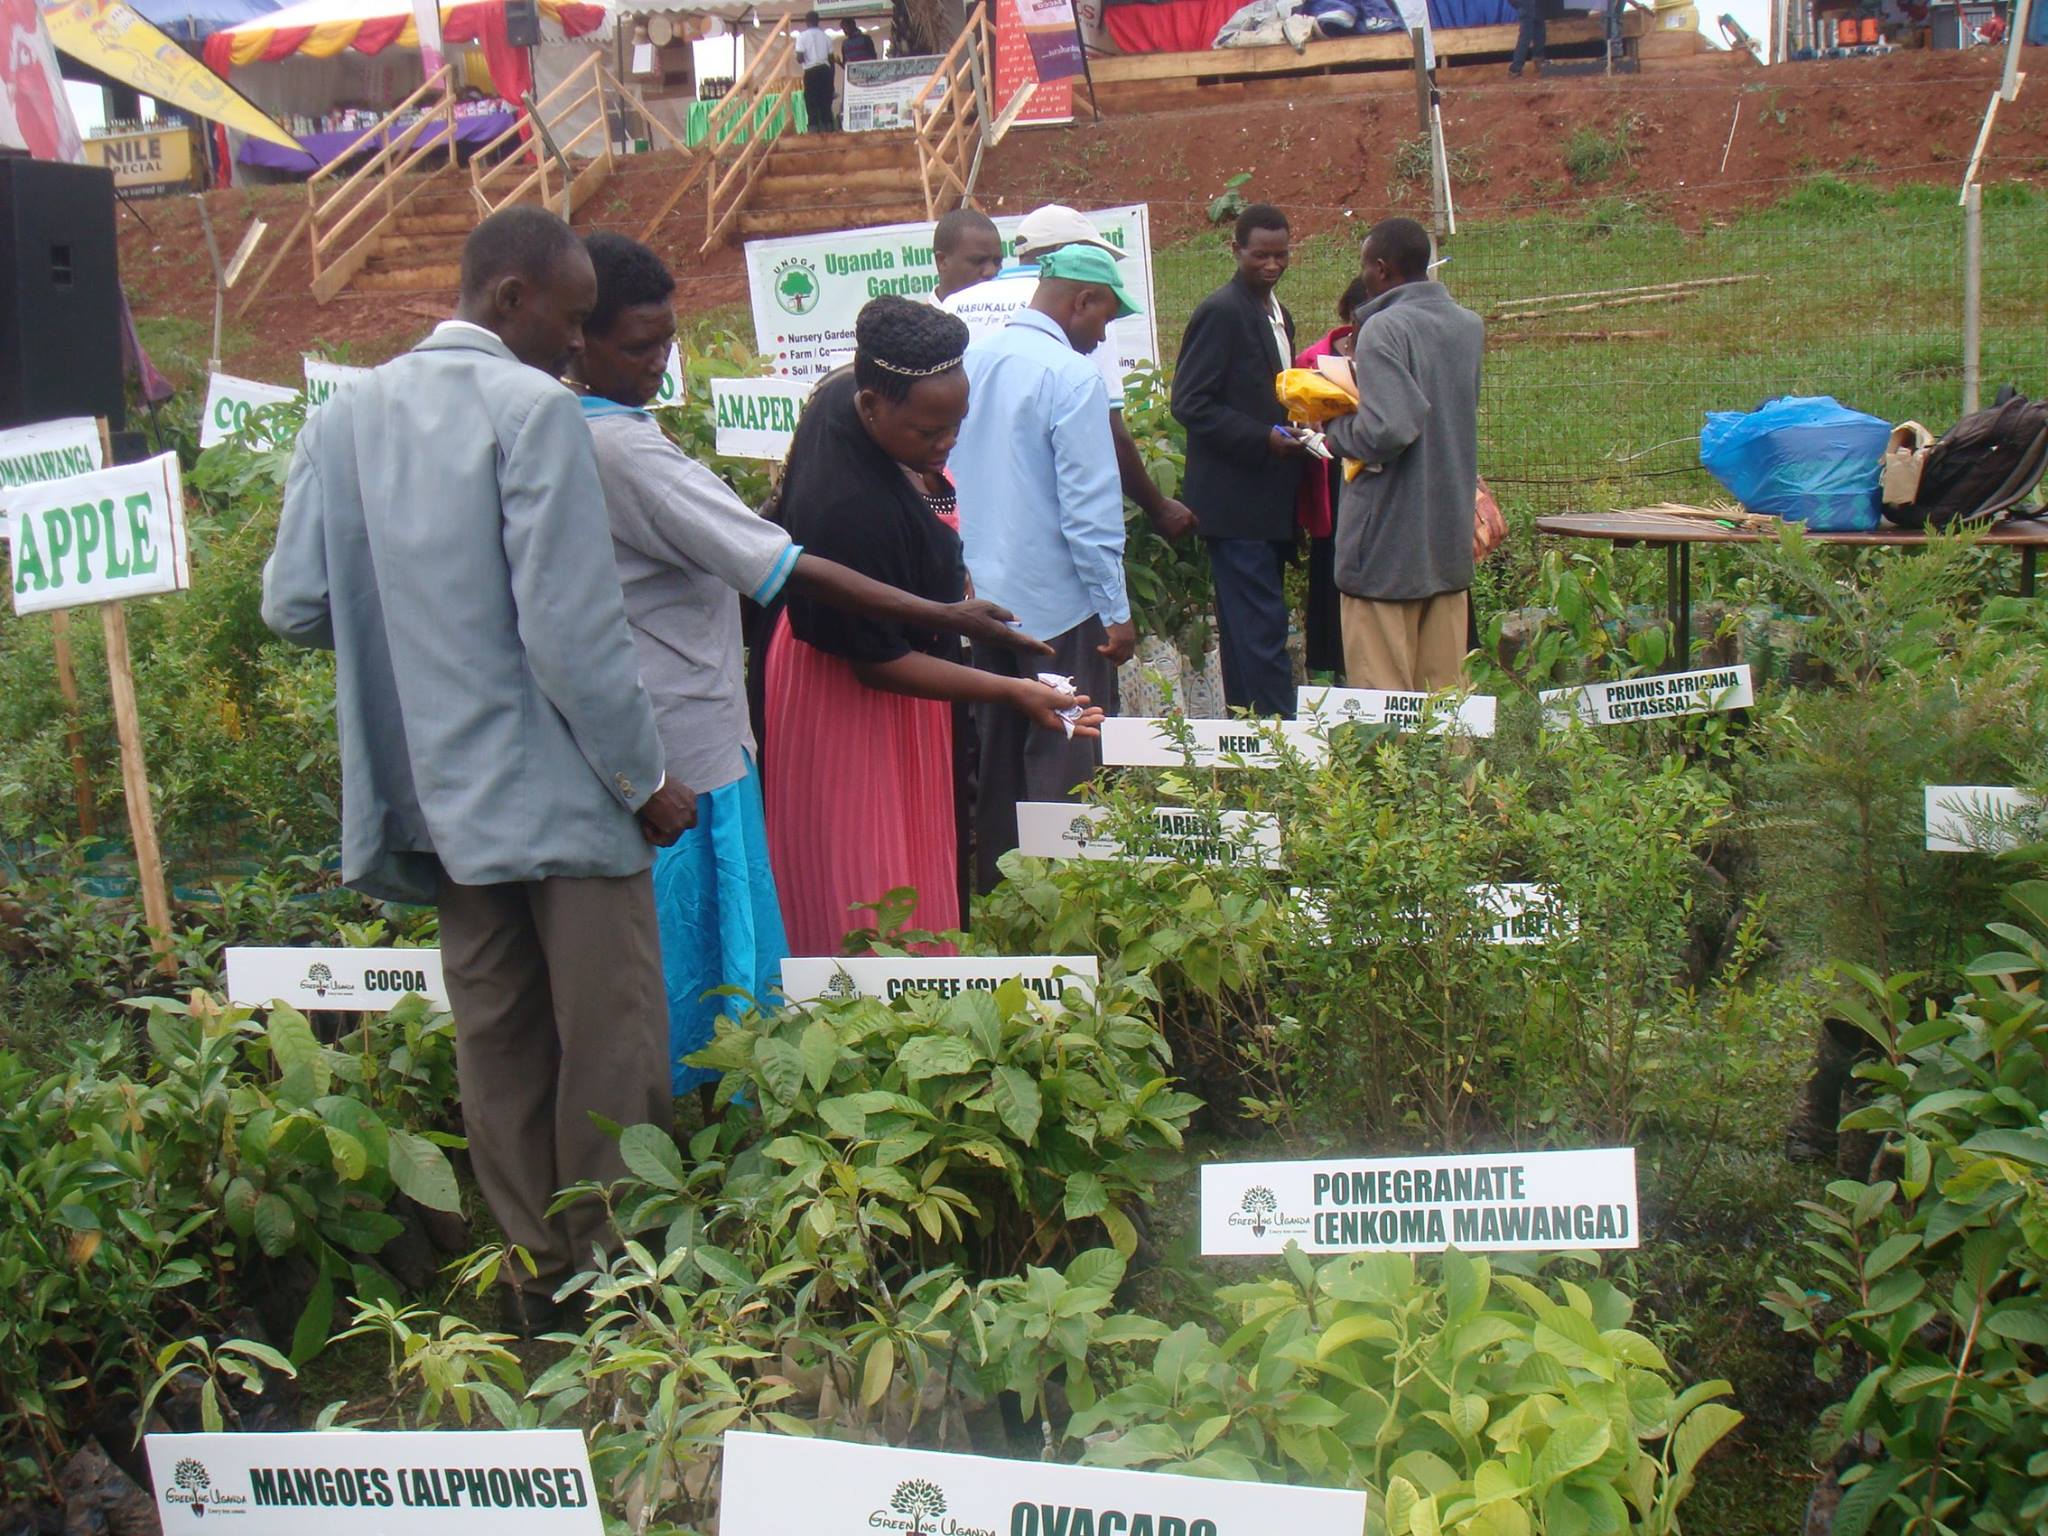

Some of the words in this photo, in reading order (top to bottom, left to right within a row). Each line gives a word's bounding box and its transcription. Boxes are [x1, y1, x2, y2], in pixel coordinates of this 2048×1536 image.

[104, 139, 162, 166] NILE
[112, 161, 162, 174] PECIAL
[773, 256, 816, 274] UNOGA
[825, 249, 894, 276] Uganda
[902, 245, 936, 267] Nur
[956, 302, 1016, 314] NABUKALU
[788, 333, 822, 343] Nursery
[790, 349, 812, 359] Farm
[792, 365, 808, 375] Soil
[717, 393, 806, 432] AMAPER
[15, 491, 158, 593] APPLE
[1606, 681, 1665, 702] PRUNUS
[1668, 671, 1739, 694] AFRICANA
[1608, 695, 1690, 719] (ENTASESA)
[1219, 736, 1260, 753] NEEM
[364, 969, 427, 992] COCOA
[1313, 1166, 1525, 1206] POMEGRANATE
[1314, 1208, 1446, 1245] (ENKOMA
[1453, 1204, 1629, 1243] MAWANGA)
[249, 1467, 394, 1507] MANGOES
[399, 1468, 588, 1508] (ALPHONSE)
